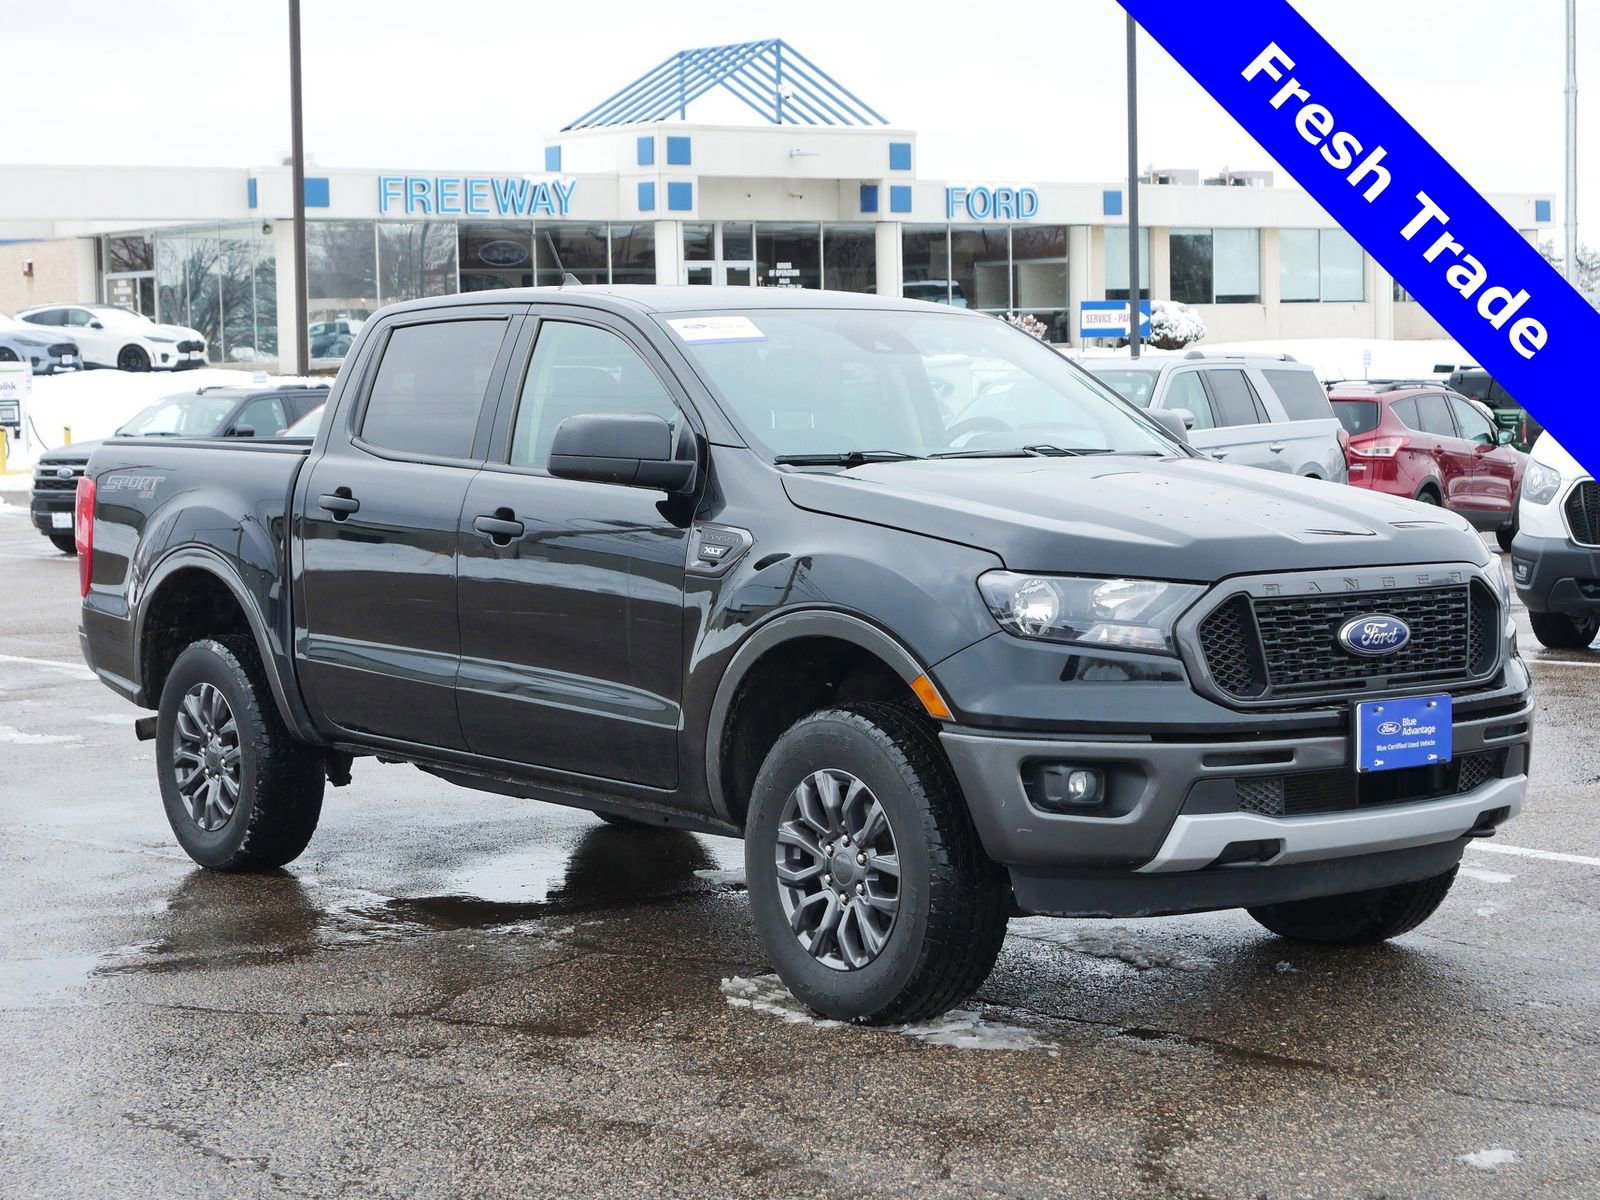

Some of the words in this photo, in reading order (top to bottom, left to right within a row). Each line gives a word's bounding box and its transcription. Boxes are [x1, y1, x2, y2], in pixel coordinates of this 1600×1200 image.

[379, 175, 577, 216] FREEWAY
[946, 183, 1039, 220] FORD
[1086, 313, 1112, 323] SERVICE
[101, 475, 166, 492] SPORT
[704, 546, 724, 555] XLT
[1263, 572, 1462, 596] RANGER
[1361, 622, 1398, 646] Ford
[1402, 718, 1417, 726] Blue
[1402, 725, 1436, 736] Advantage
